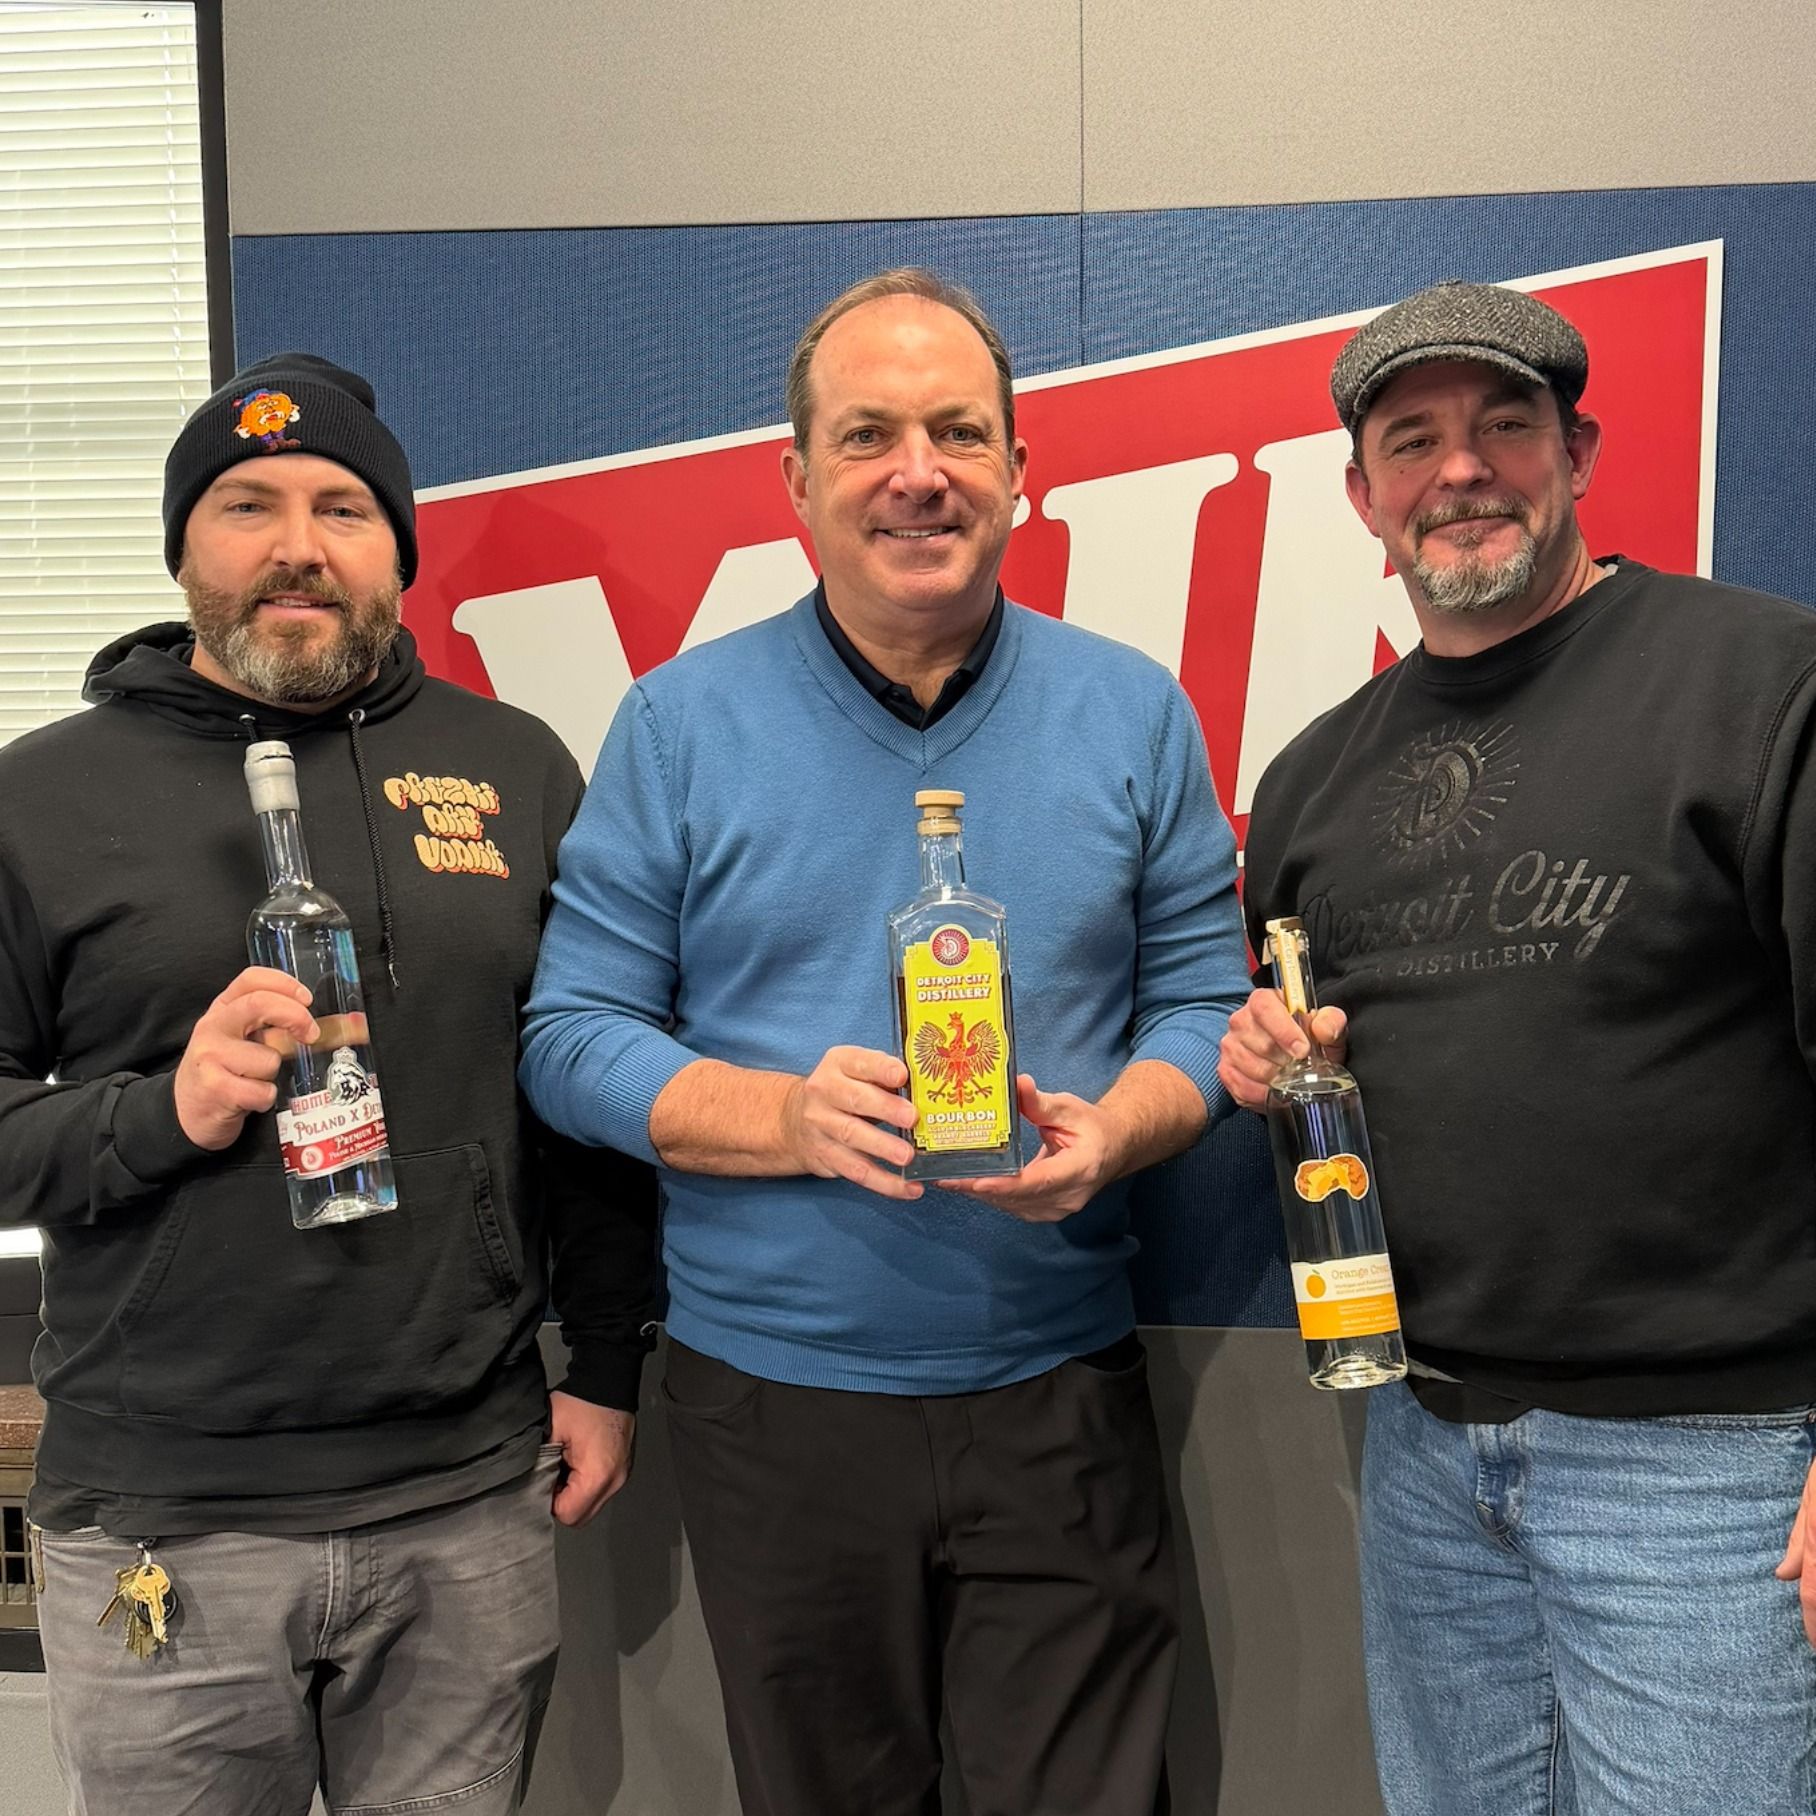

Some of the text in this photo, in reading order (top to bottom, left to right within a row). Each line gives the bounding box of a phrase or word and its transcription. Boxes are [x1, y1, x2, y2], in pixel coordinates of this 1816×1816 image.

[413, 834, 510, 879] VODKA
[1488, 850, 1632, 961] City
[1398, 942, 1560, 977] DISTILLERY
[917, 973, 991, 989] DETROIT CITY
[917, 987, 991, 1002] DISTILLERY
[927, 1110, 997, 1125] BOURBON
[1331, 1267, 1369, 1279] Orange
